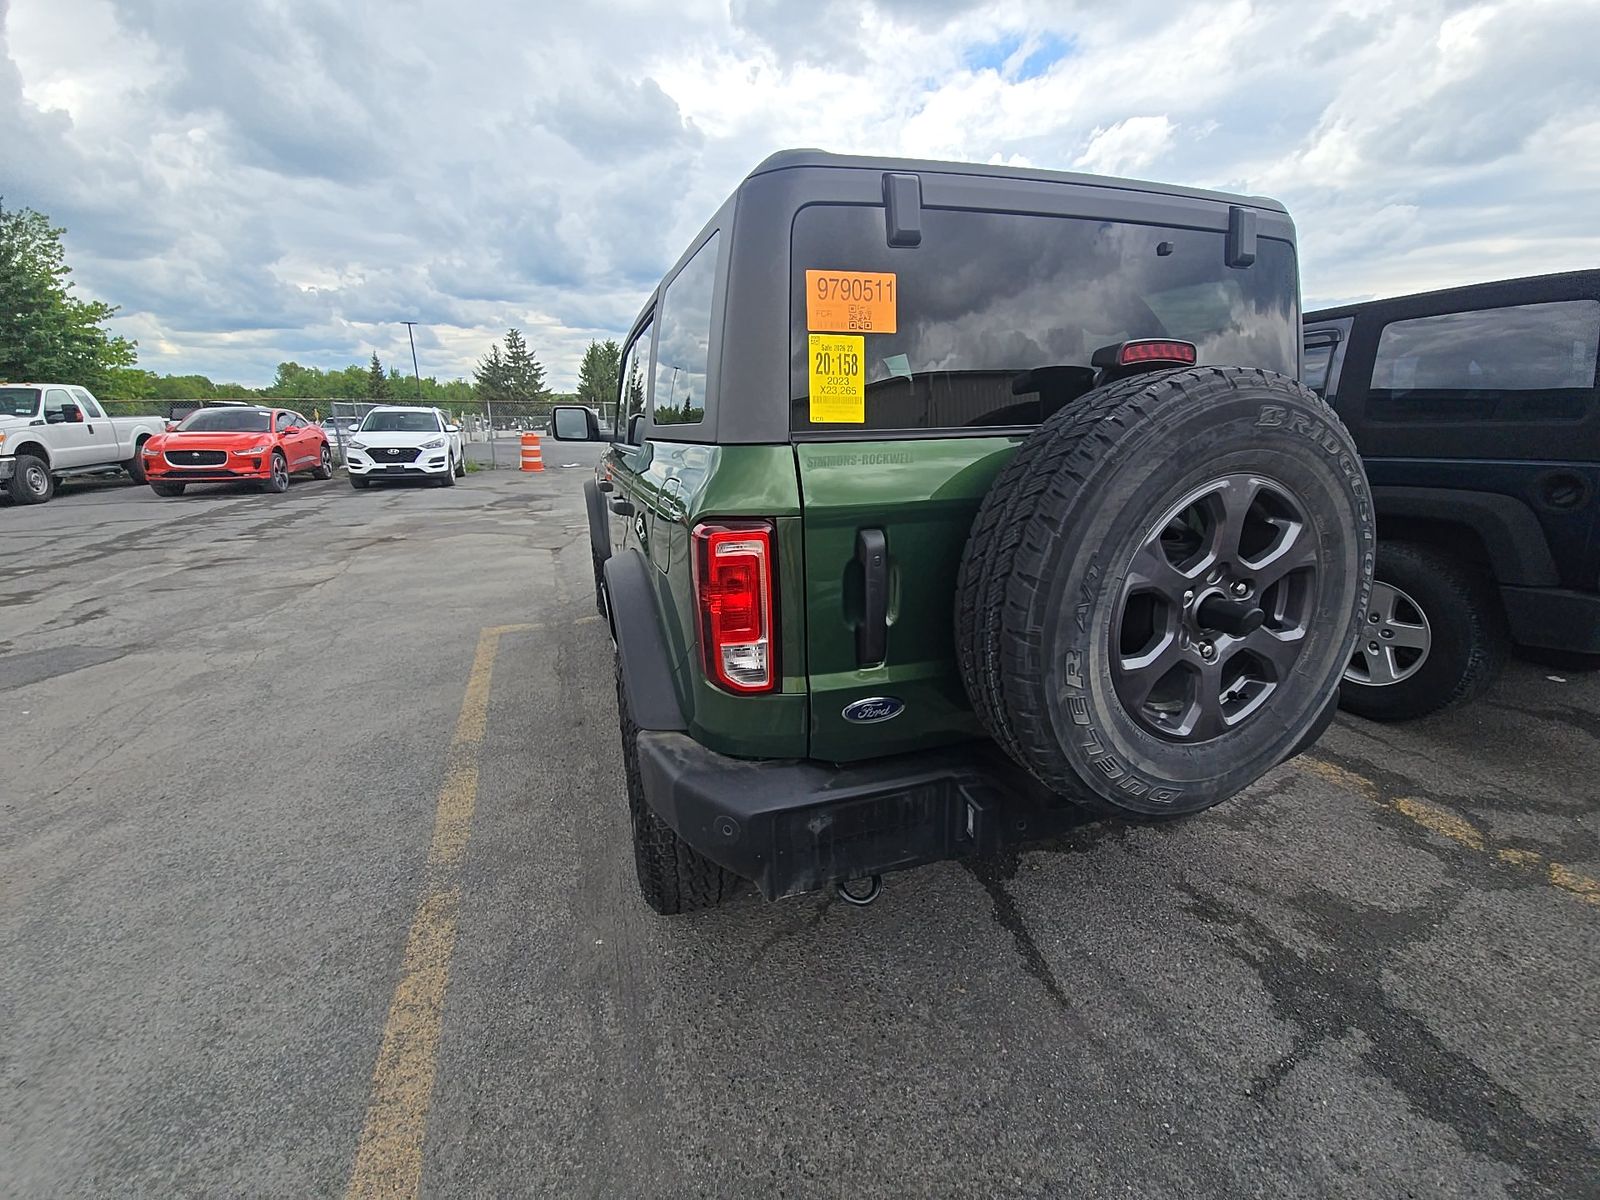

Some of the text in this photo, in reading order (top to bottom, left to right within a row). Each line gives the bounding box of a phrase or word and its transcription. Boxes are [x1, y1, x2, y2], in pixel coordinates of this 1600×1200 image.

[817, 277, 893, 303] 9790511
[815, 352, 858, 376] 20:158
[819, 385, 857, 396] X23,265
[827, 376, 850, 386] 2023
[857, 702, 891, 719] Ford
[1065, 649, 1185, 804] DUELER
